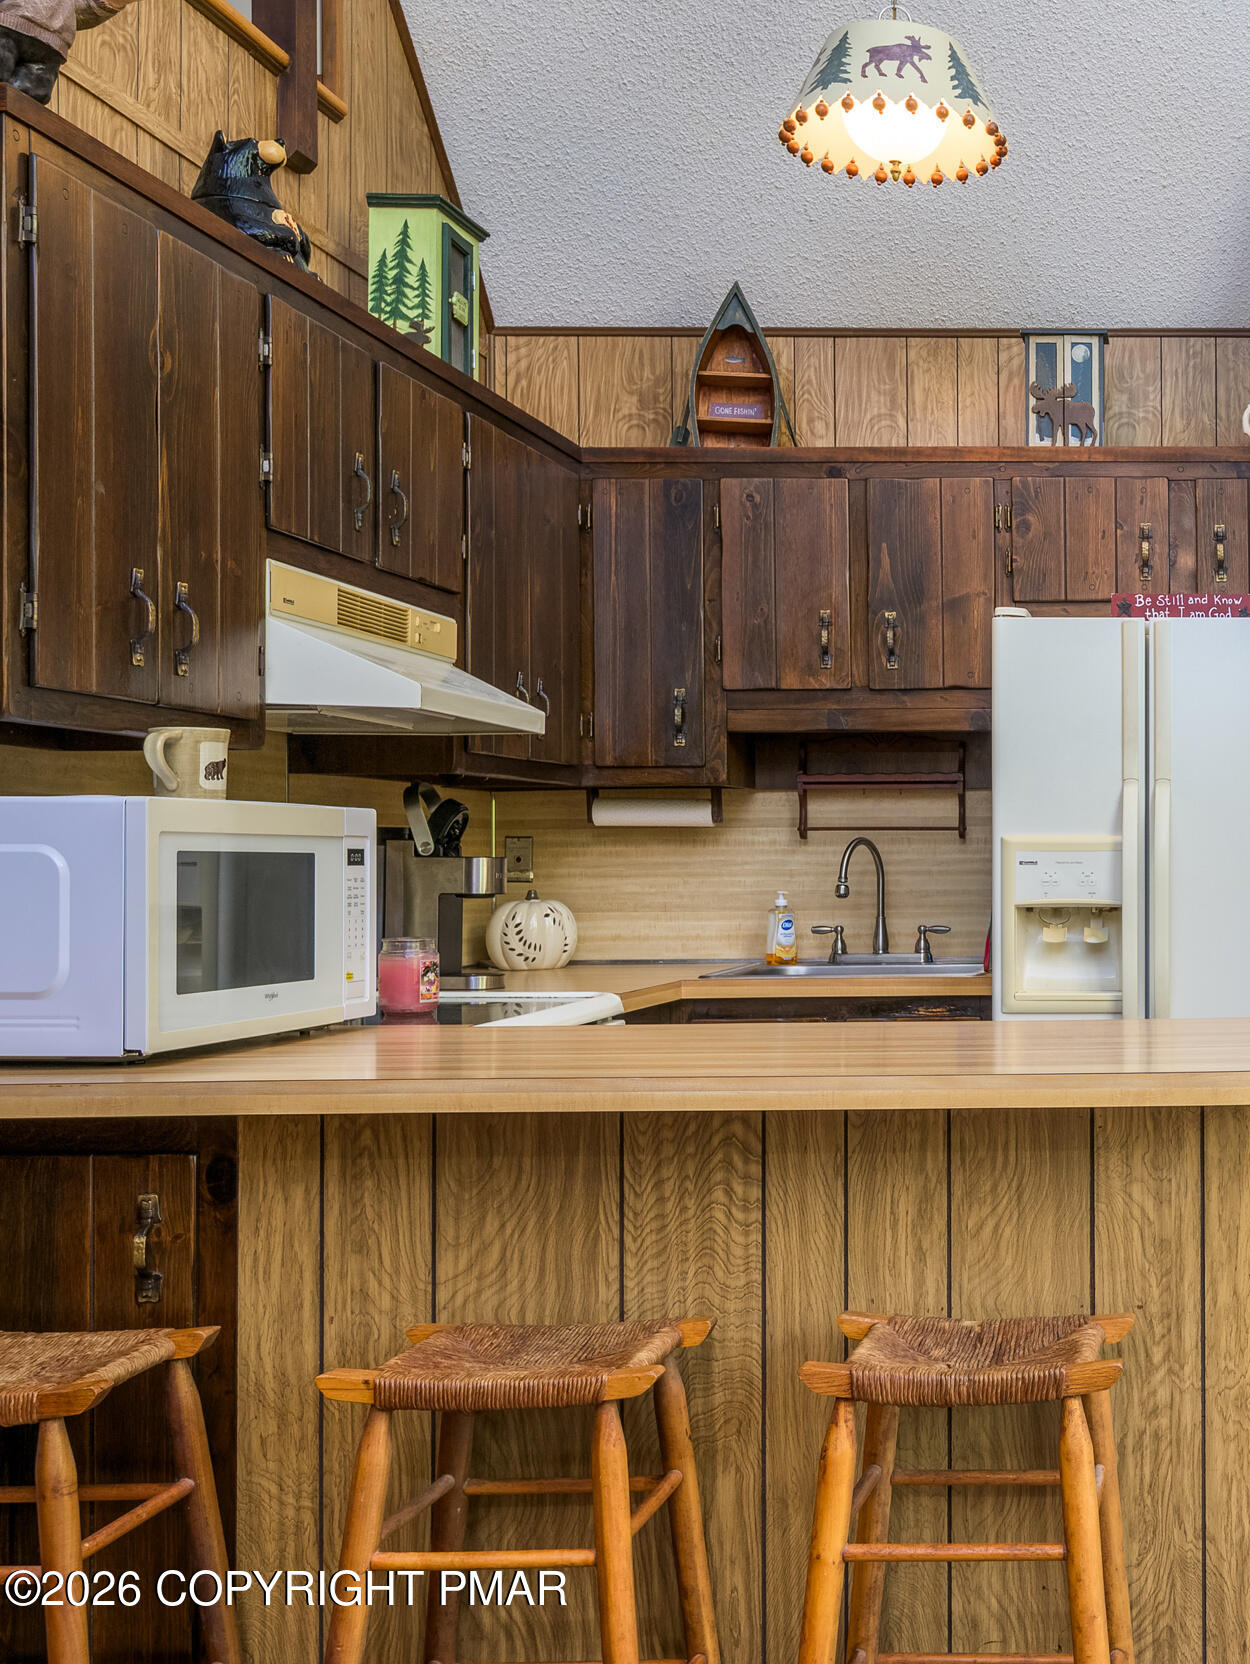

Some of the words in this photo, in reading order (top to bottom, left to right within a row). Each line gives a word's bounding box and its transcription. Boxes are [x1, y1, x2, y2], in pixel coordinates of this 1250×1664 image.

[714, 406, 732, 415] GONE
[1134, 594, 1152, 607] Be
[1156, 594, 1184, 606] Still
[1188, 594, 1208, 604] and
[1213, 594, 1243, 605] Know
[1145, 607, 1170, 618] that
[1178, 606, 1186, 618] I
[1208, 606, 1232, 618] God
